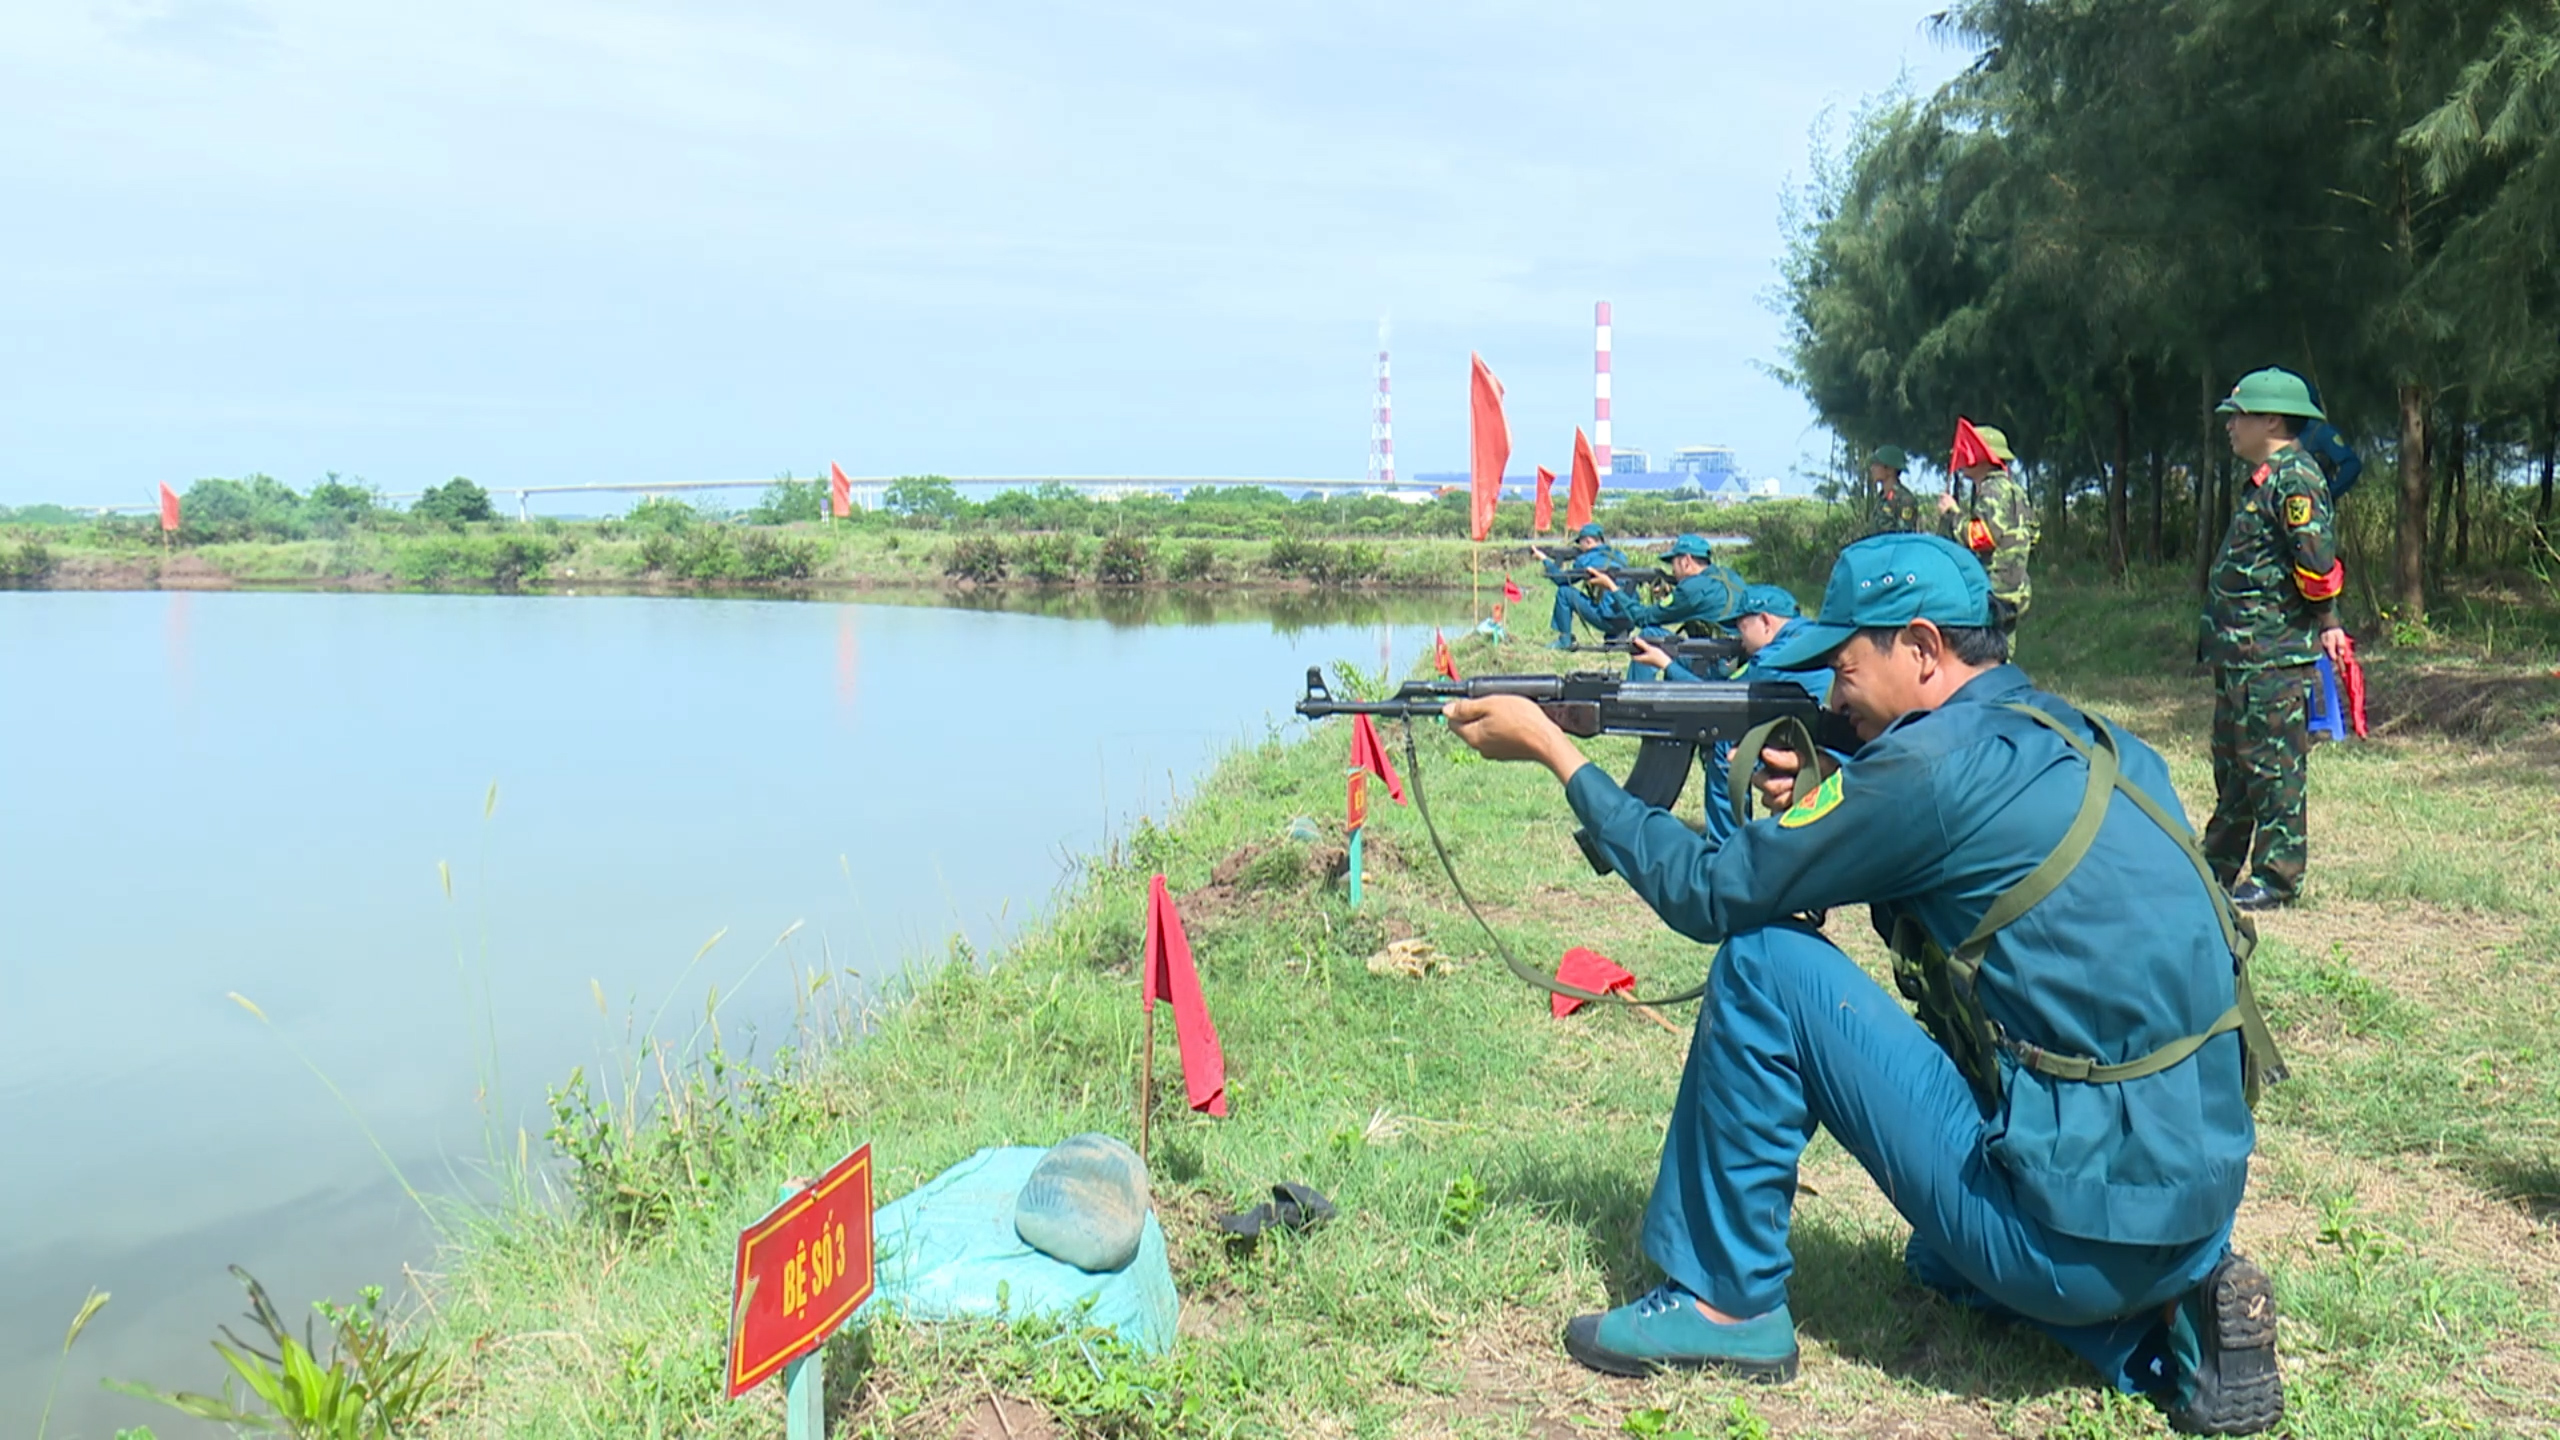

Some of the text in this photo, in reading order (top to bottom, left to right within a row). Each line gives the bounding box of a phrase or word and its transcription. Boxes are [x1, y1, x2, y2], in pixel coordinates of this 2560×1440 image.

[783, 1209, 846, 1320] BỆ SỐ 3
